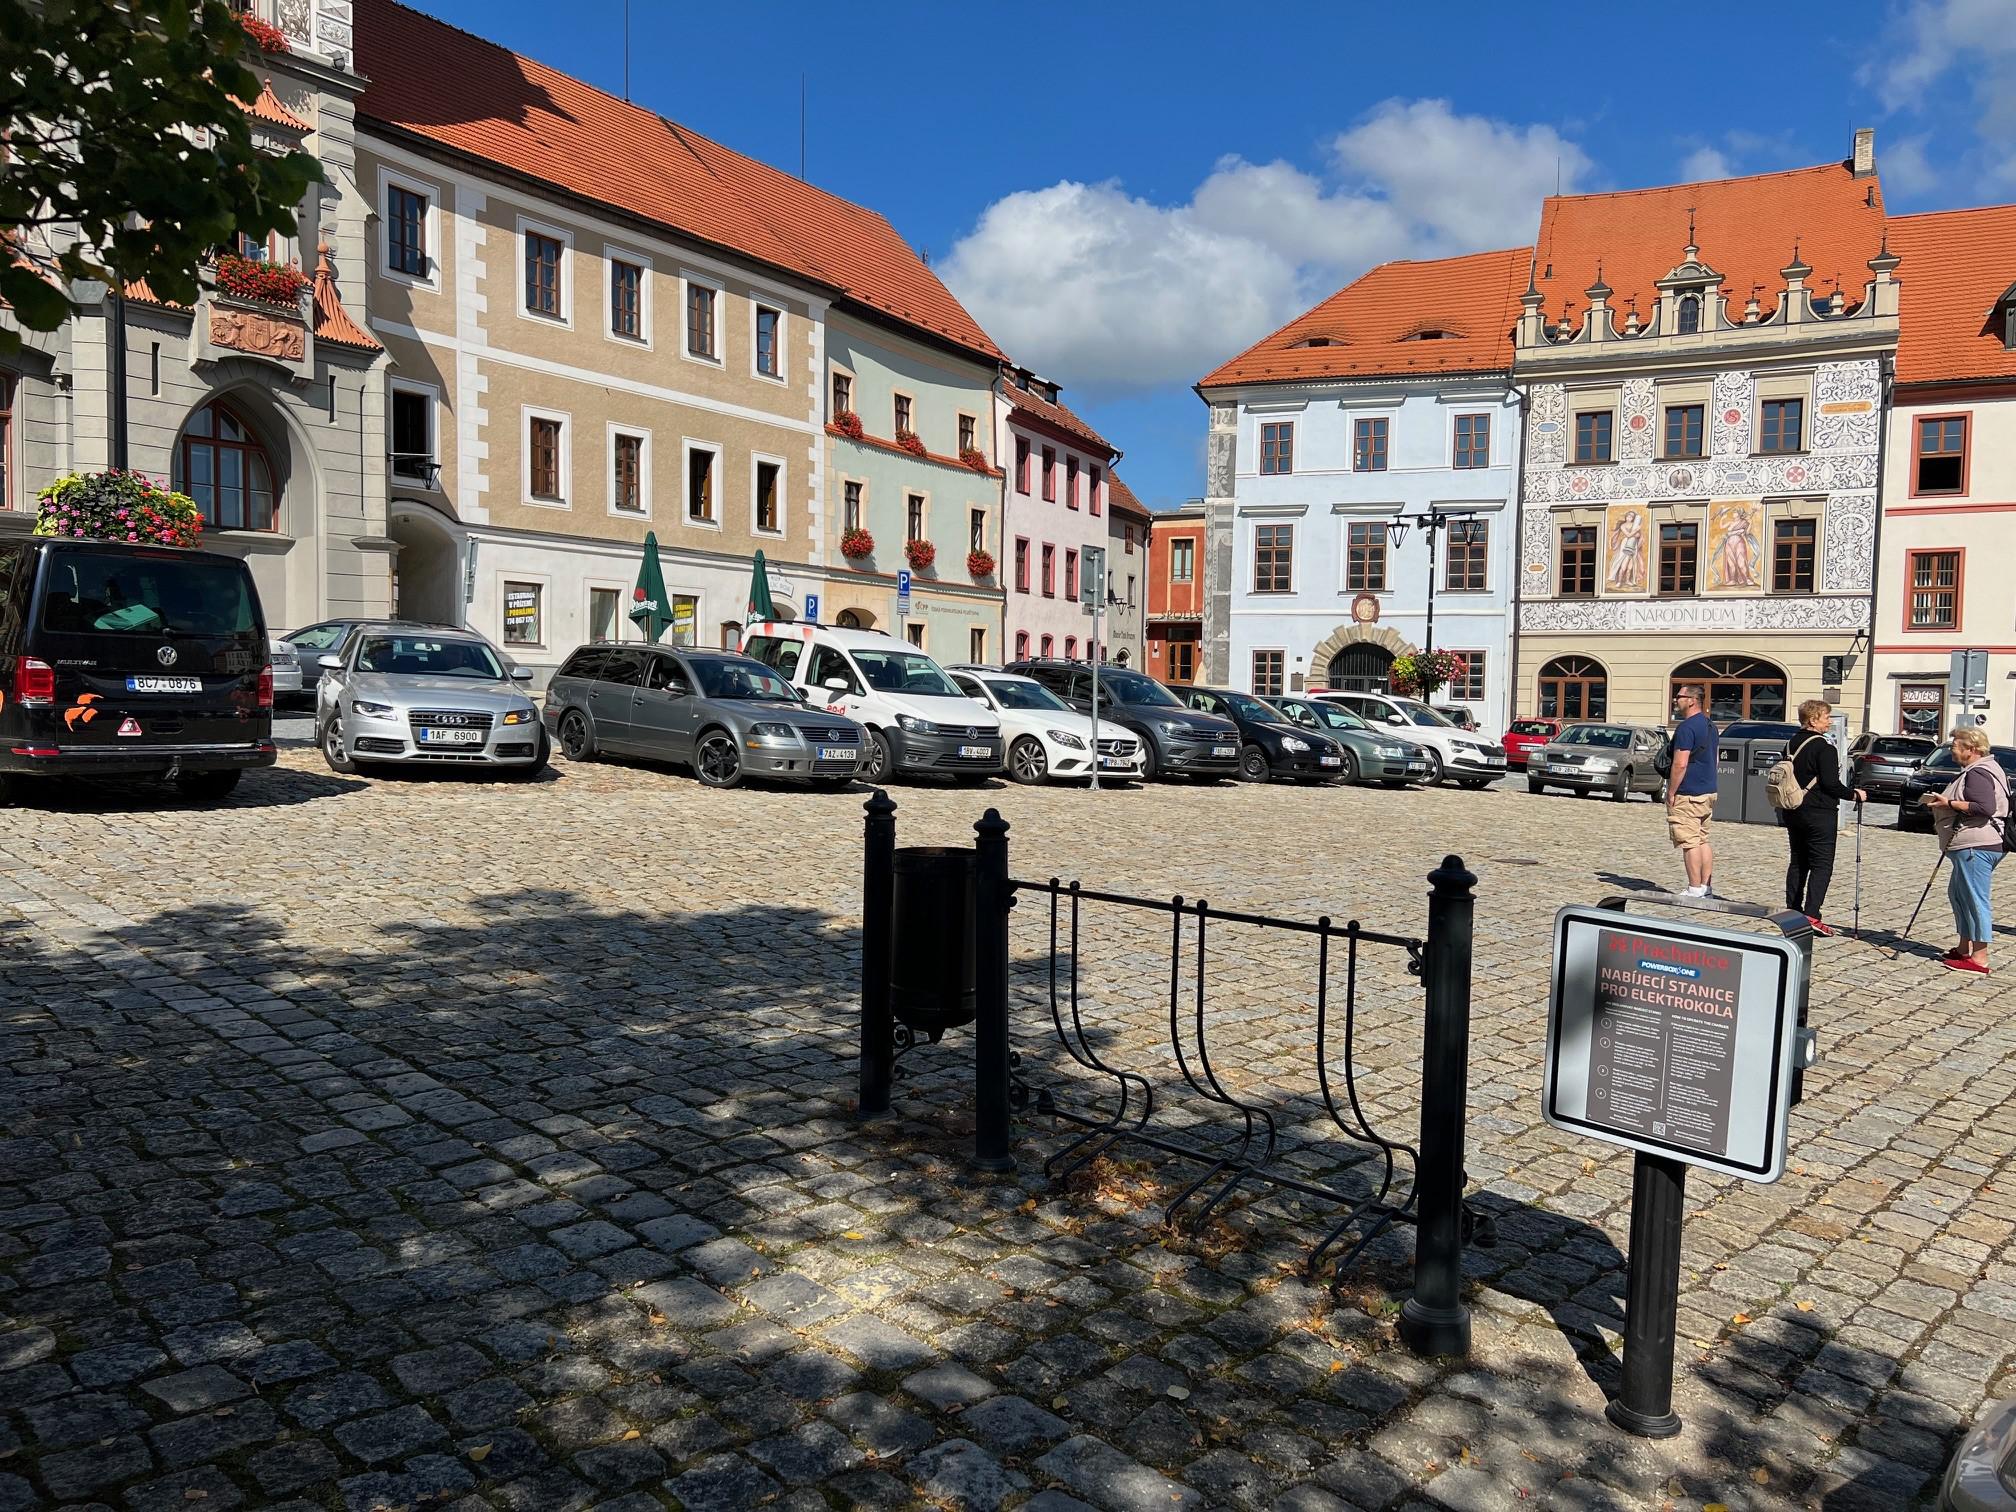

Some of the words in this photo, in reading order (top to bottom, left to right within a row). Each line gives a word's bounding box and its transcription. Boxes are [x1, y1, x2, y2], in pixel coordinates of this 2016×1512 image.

[900, 574, 908, 589] P
[808, 598, 815, 614] P
[137, 677, 159, 689] 8C7
[168, 677, 197, 690] 0876
[430, 730, 447, 740] 1AF
[454, 731, 478, 741] 6900
[1632, 938, 1729, 969] Prachatice
[1601, 967, 1666, 989] NABÍJECÍ
[1668, 980, 1735, 1003] STANICE
[1600, 982, 1628, 997] PRO
[1631, 988, 1734, 1019] ELEKTROKOLA
